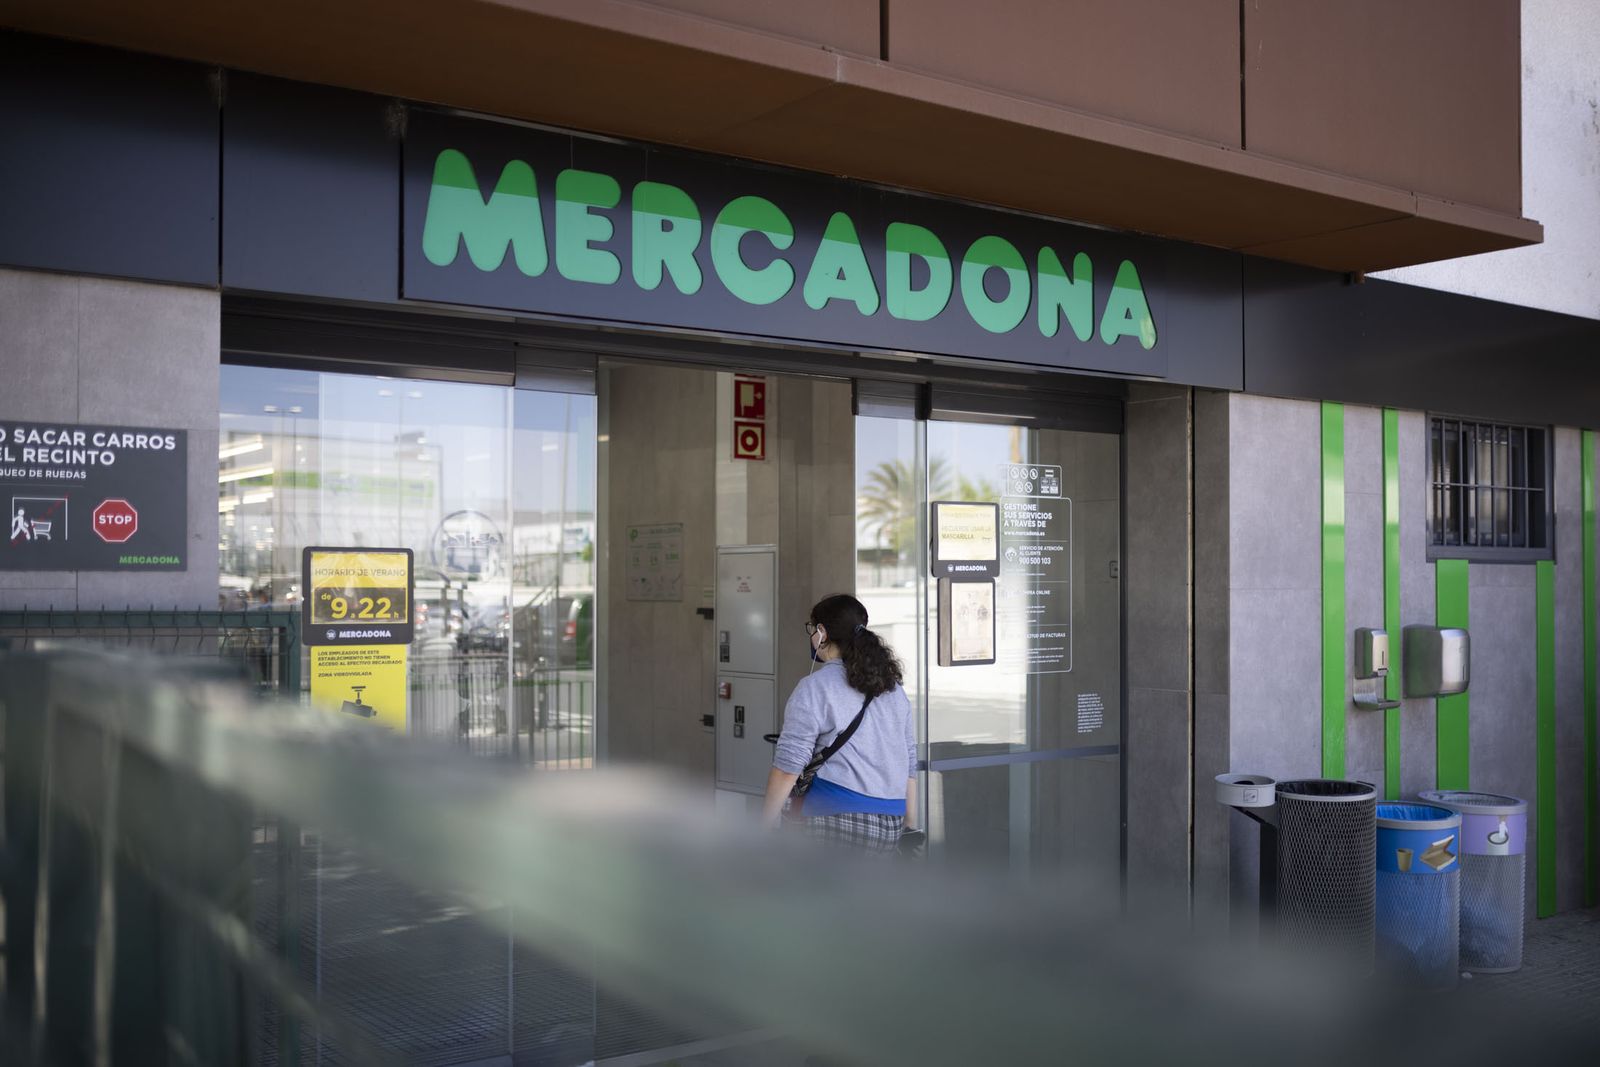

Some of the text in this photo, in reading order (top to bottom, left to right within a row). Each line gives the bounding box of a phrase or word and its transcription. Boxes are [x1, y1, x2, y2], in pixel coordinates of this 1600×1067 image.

[422, 148, 1158, 350] MERCADONA
[14, 429, 86, 446] SACAR
[93, 432, 176, 450] CARROS
[0, 447, 115, 466] L RECINTO
[29, 469, 43, 477] DE
[45, 470, 87, 479] RUEDAS
[1003, 503, 1037, 511] GESTIONE
[99, 514, 132, 525] STOP
[1003, 511, 1052, 520] SUS SERVICIOS
[1010, 519, 1036, 528] TRAVÉS
[1037, 520, 1047, 528] DE
[119, 556, 180, 564] MERCADONA
[1019, 557, 1051, 565] 900 500 103
[315, 568, 406, 577] HORARIO DE VERANO
[331, 597, 348, 619] 9
[358, 597, 391, 619] 22
[339, 630, 391, 638] MERCADONA
